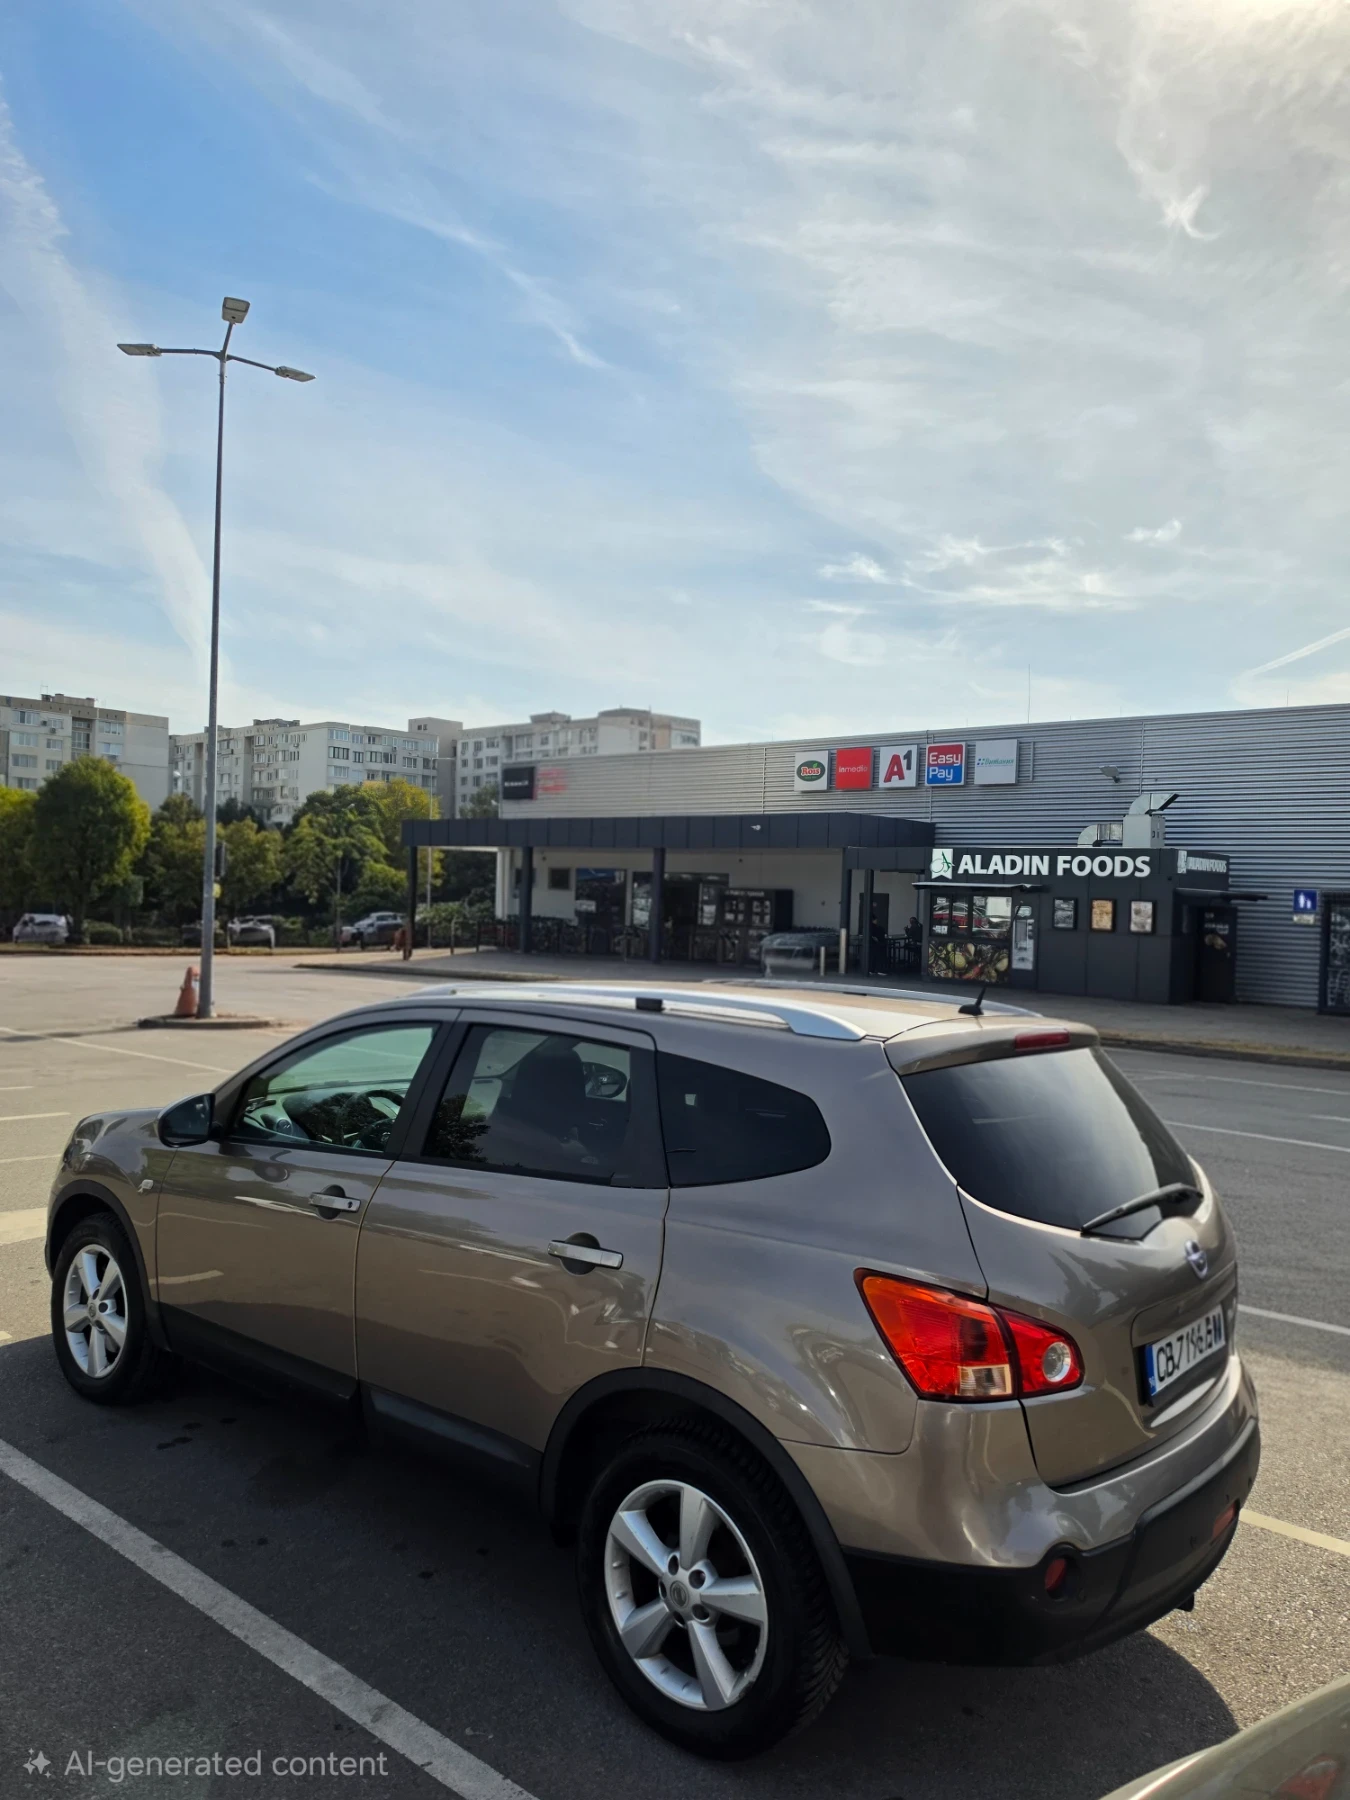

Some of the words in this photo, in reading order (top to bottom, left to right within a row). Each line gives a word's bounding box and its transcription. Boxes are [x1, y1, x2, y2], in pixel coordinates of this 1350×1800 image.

[883, 750, 912, 783] A1
[929, 752, 961, 767] Easy
[929, 767, 954, 781] Pay
[957, 854, 1049, 876] ALADIN
[1056, 855, 1151, 878] FOODS
